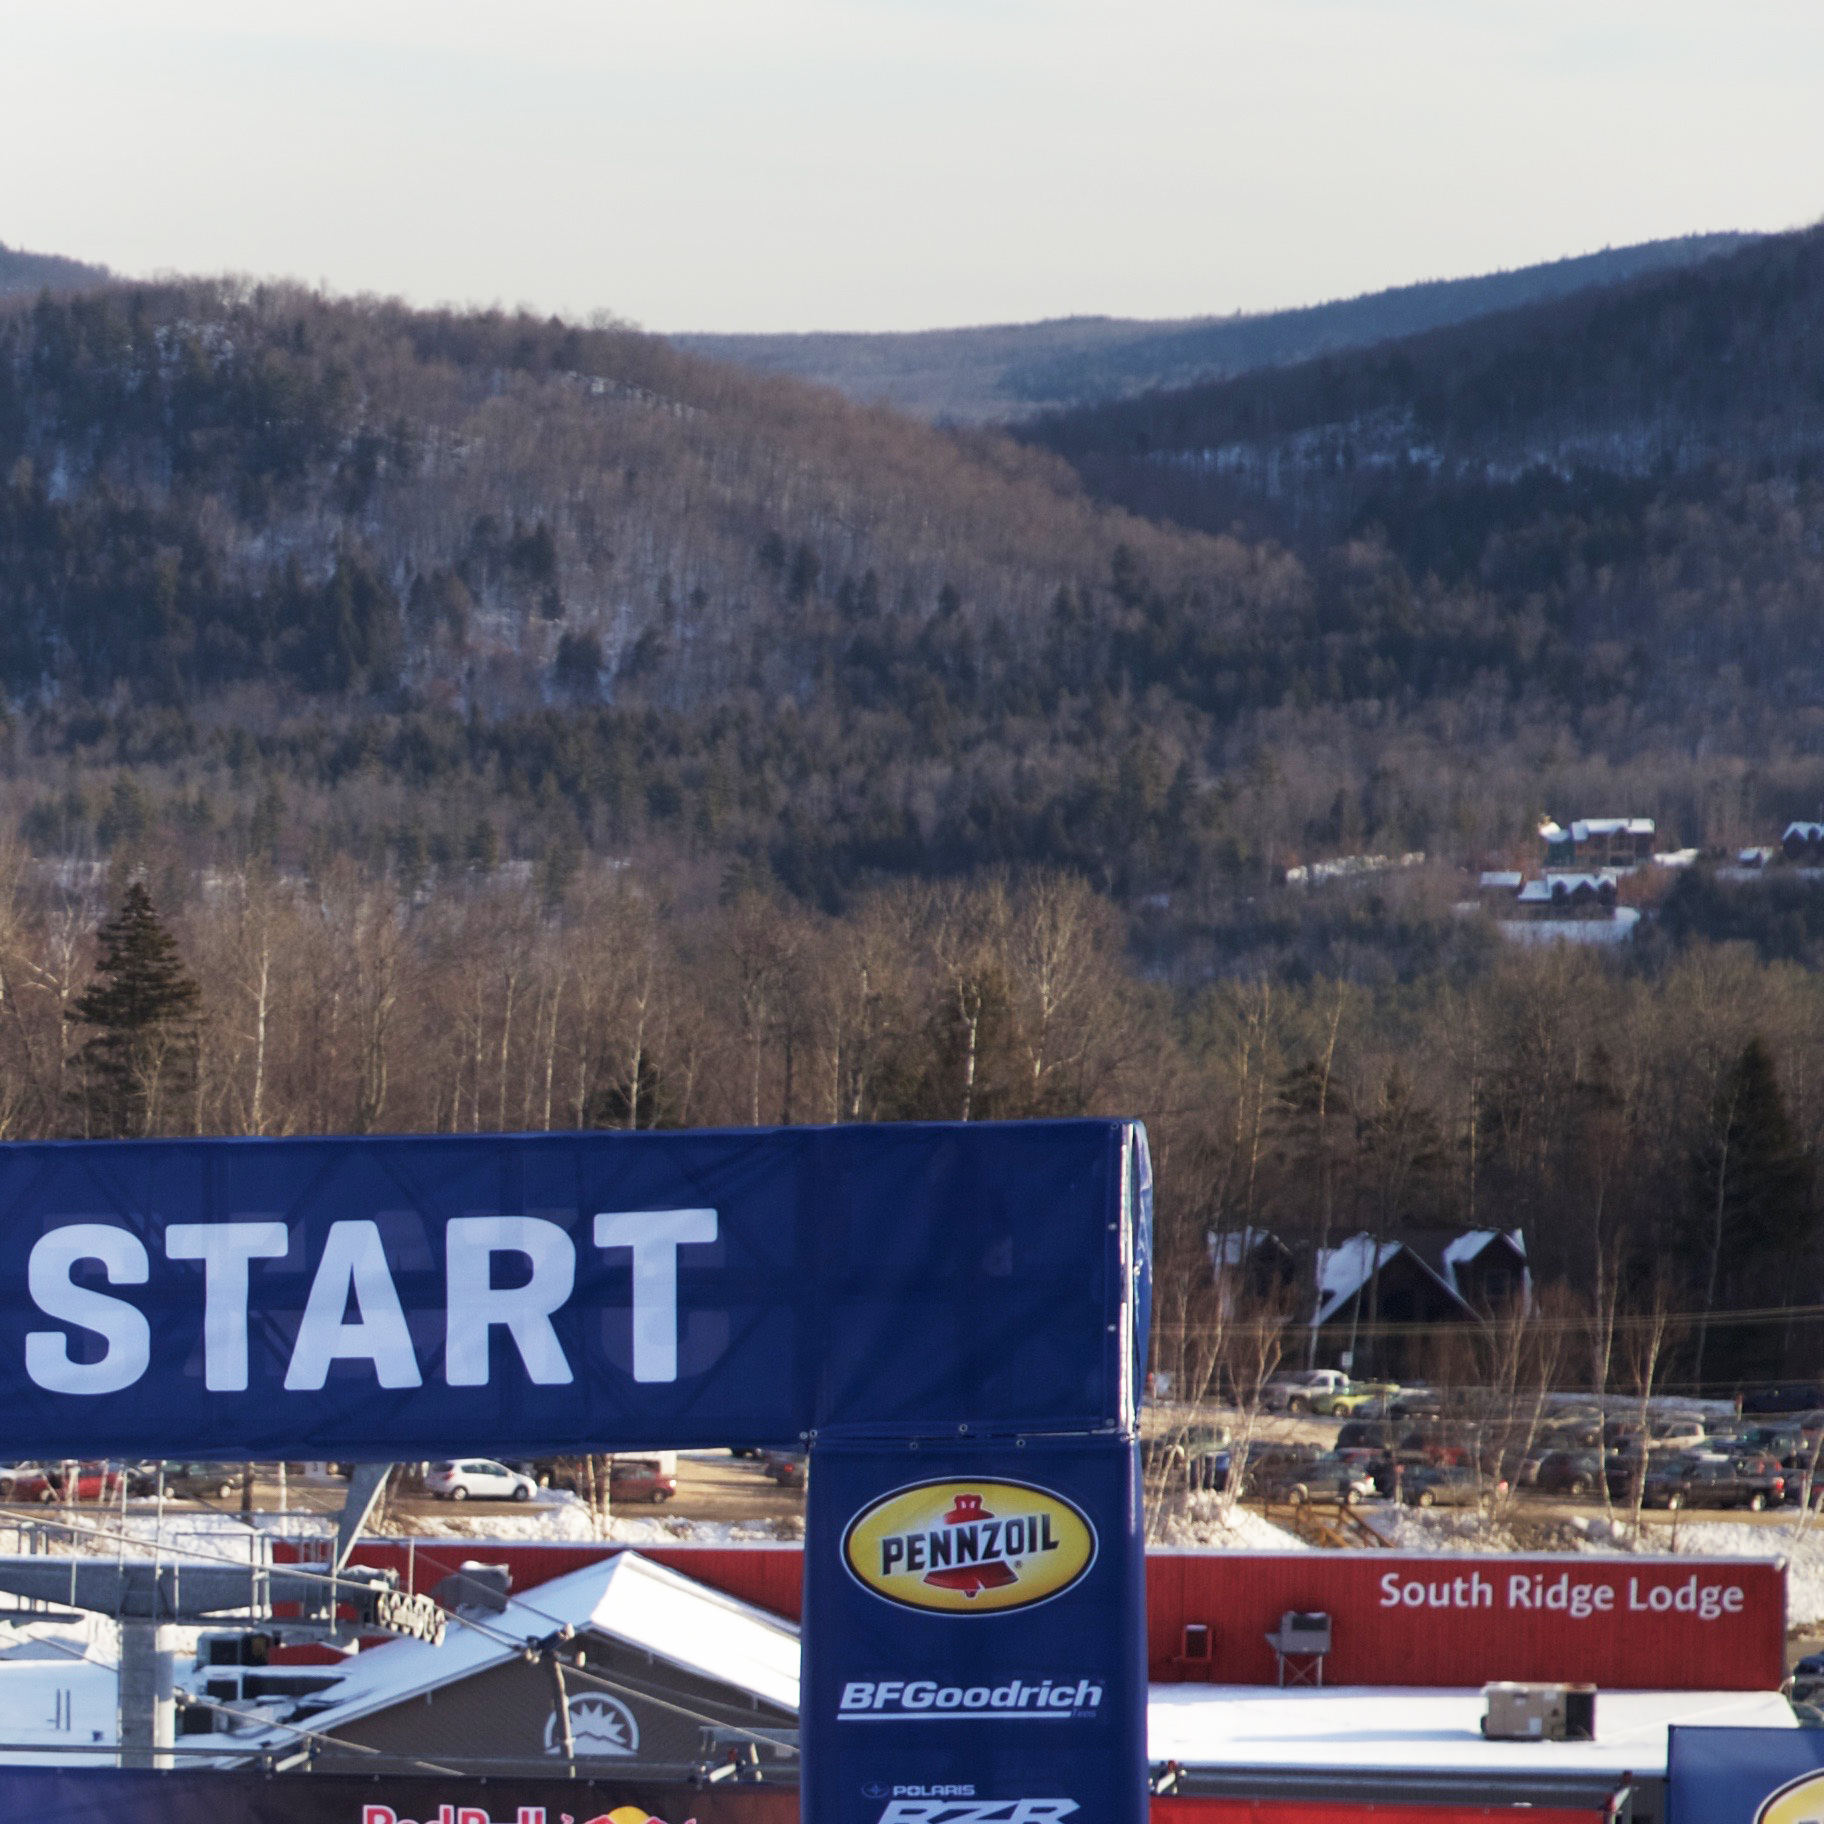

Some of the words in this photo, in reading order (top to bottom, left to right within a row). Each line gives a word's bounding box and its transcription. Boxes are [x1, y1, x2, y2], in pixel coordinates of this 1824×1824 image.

[25, 1208, 718, 1395] START
[881, 1513, 1060, 1576] PENNZOIL
[1379, 1571, 1493, 1609] South
[1507, 1573, 1615, 1620] Ridge
[1629, 1574, 1745, 1621] Lodge
[839, 1679, 1103, 1709] BFGoodrich
[893, 1784, 976, 1797] POLARIS
